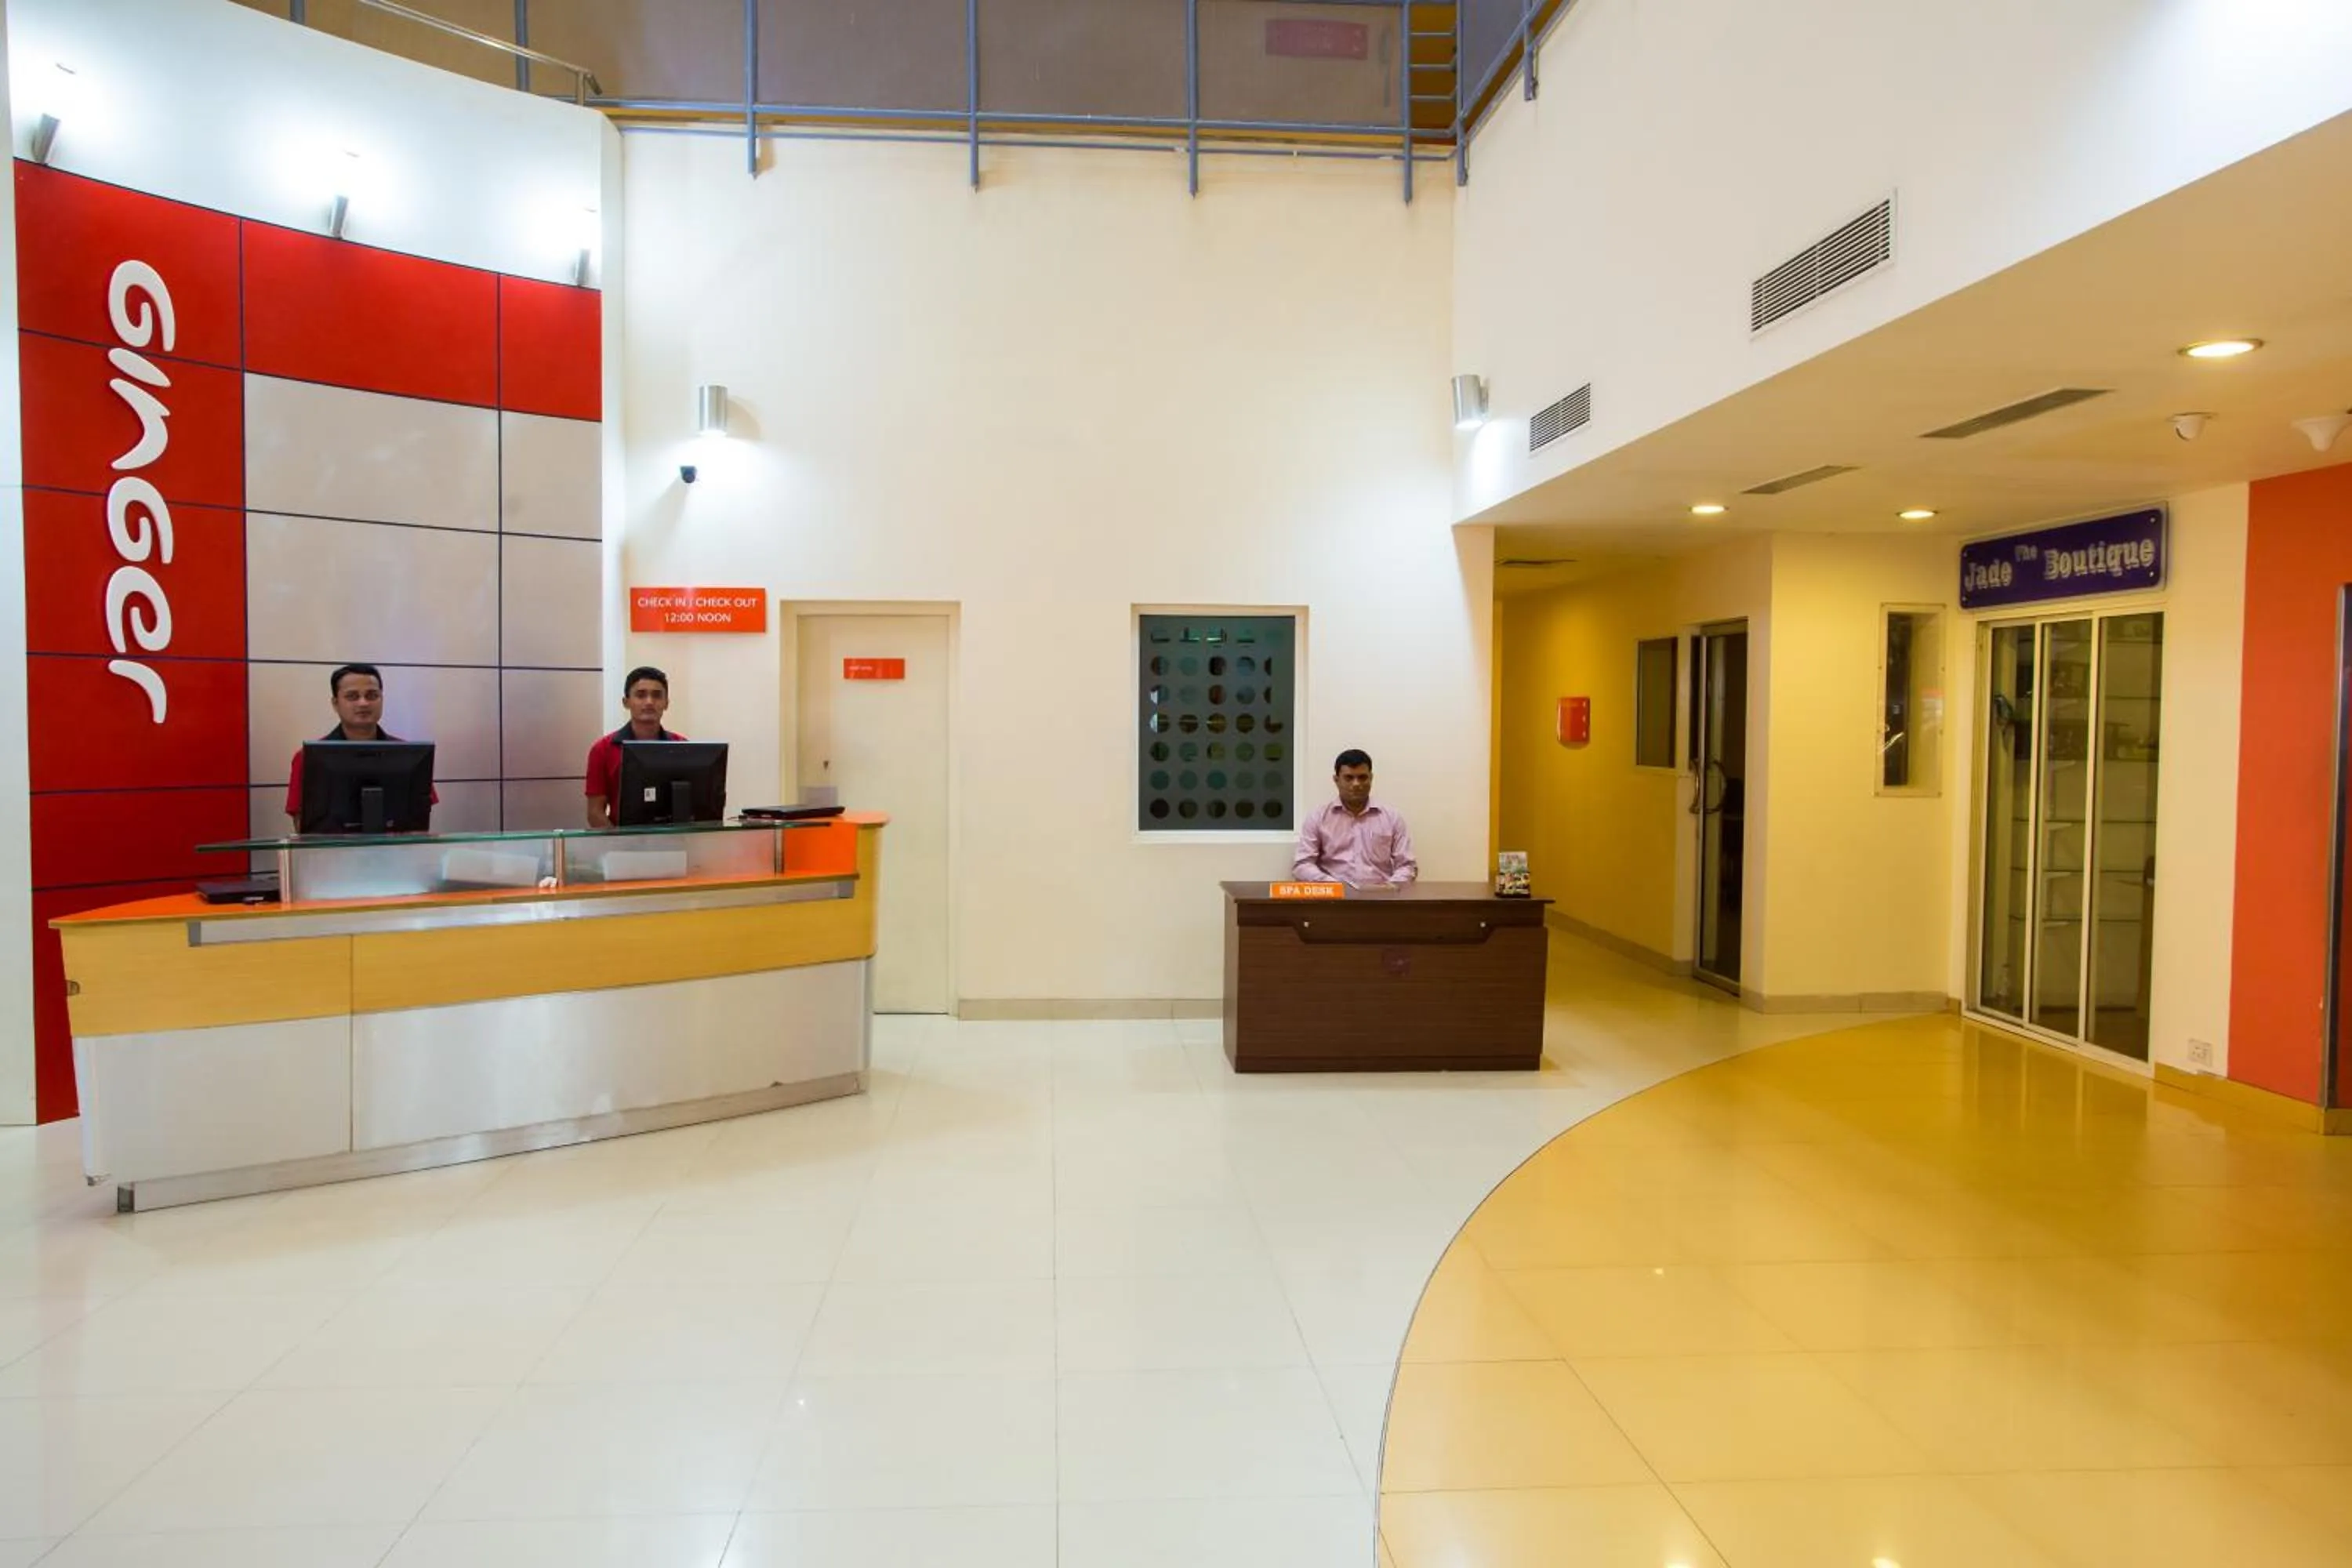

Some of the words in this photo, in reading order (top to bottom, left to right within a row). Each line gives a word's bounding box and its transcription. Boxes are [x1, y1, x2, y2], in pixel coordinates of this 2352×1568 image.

[1964, 559, 2013, 592] Jade
[2044, 538, 2155, 580] Boutique
[637, 597, 672, 608] CHECK
[675, 597, 686, 608] IN
[695, 597, 731, 608] CHECK
[734, 597, 757, 608] OUT
[664, 612, 694, 623] 12:00
[697, 612, 731, 623] NOON
[1279, 885, 1301, 895] SPA
[1304, 885, 1333, 895] DESK
